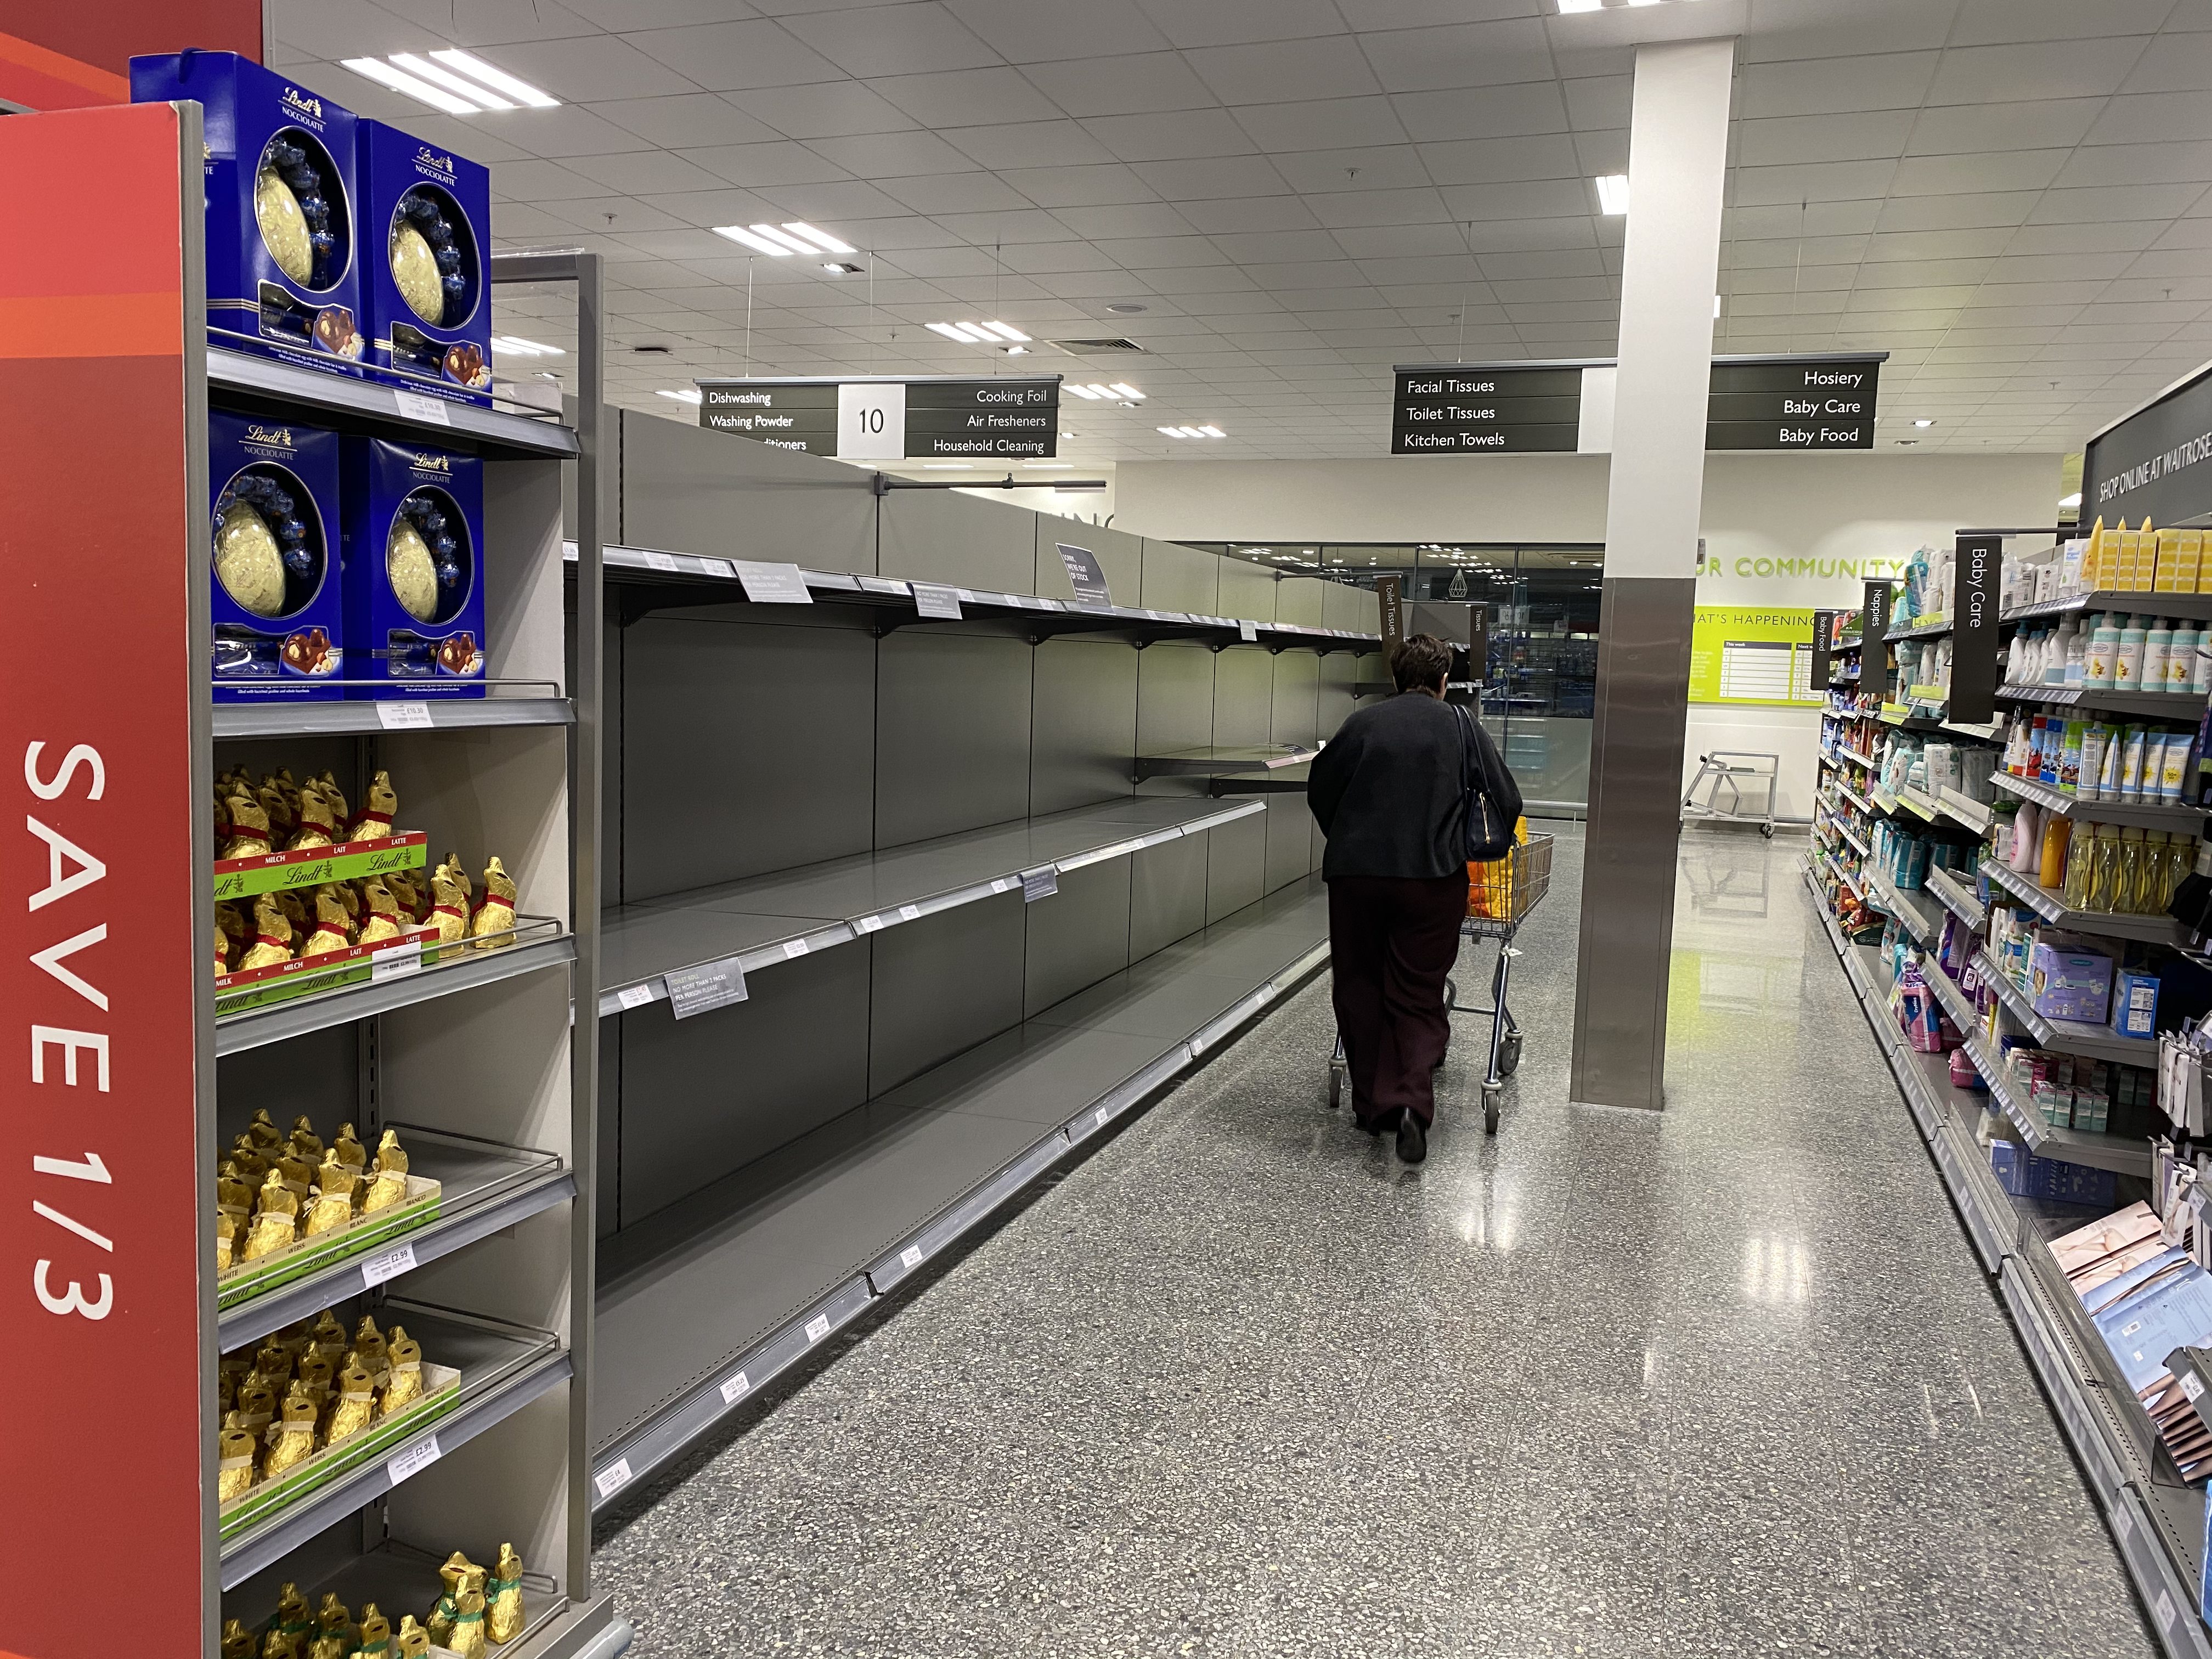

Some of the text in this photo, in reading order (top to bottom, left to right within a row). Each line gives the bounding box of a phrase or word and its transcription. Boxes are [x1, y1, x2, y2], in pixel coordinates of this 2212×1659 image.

[282, 106, 324, 133] NOCCIOLATTE
[415, 164, 455, 187] NOCCIOLATTE
[1407, 380, 1494, 393] Facial Tissues
[1804, 371, 1863, 388] Hosiery
[709, 392, 771, 406] Dishwashing
[977, 390, 1047, 405] Cooking Foil
[1407, 406, 1496, 420] Toilet Tissues
[1784, 399, 1861, 416] Baby Care
[709, 415, 793, 428] Washing Powder
[859, 408, 883, 434] 10
[967, 415, 1046, 427] Air Fresheners
[245, 425, 283, 444] Lindt
[1404, 432, 1504, 447] Kitchen Towels
[1780, 427, 1859, 445] Baby Food
[244, 445, 294, 460] NOCCIOLATTE
[934, 440, 1044, 454] Household Cleaning
[413, 471, 450, 484] NOCCIOLATTE
[2100, 476, 2119, 503] SHOP
[2120, 461, 2150, 494] ONLINE
[2150, 456, 2163, 481] AT
[1735, 557, 1904, 578] COMMUNITY
[1967, 548, 1987, 628] Baby Care
[1870, 589, 1882, 627] Nappies
[1694, 614, 1726, 624] AT'S
[1818, 617, 1827, 633] Baby
[265, 837, 407, 864] MILCH LAIT LATTE
[283, 853, 403, 885] Lindt Lindt
[216, 934, 420, 987] MILK MILCH LAIT LATTE
[685, 990, 702, 998] PERSON
[24, 741, 114, 1321] SAVE 1/3
[217, 1269, 239, 1282] WHITE
[287, 1243, 306, 1254] WEISS
[349, 1217, 368, 1229] BLANC
[392, 1250, 408, 1263] £2.99
[416, 1442, 431, 1457] £2.99
[239, 1489, 259, 1504] WHITE
[308, 1453, 326, 1465] WEISS
